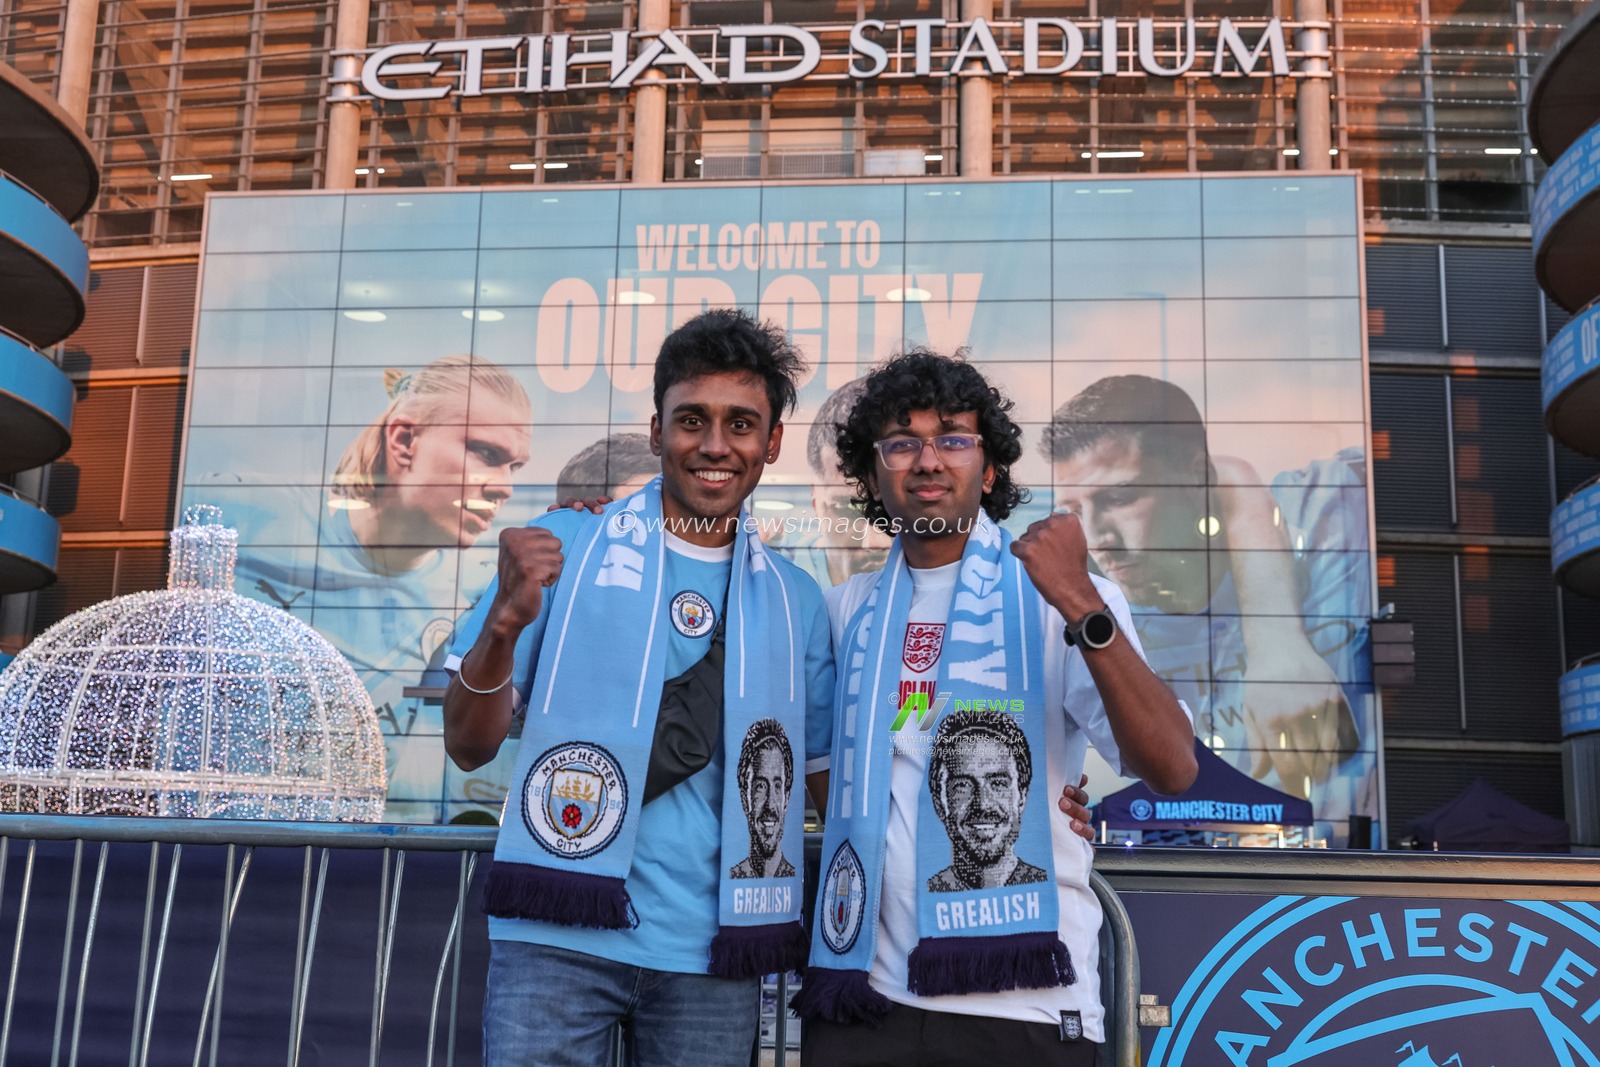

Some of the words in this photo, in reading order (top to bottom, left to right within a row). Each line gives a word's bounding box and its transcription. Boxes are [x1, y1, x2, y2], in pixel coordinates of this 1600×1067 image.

[361, 25, 821, 99] ETIHAD
[849, 17, 1290, 79] STADIUM
[636, 221, 828, 271] WELCOME
[836, 220, 881, 268] TO
[676, 594, 711, 613] MANCHESTER
[541, 750, 617, 791] MANCHESTER
[1155, 801, 1250, 821] MANCHESTER
[1251, 804, 1284, 822] CITY
[556, 838, 582, 852] CITY
[733, 885, 792, 914] GREALISH
[935, 891, 1040, 931] GREALISH
[1214, 908, 1600, 1067] ANCHESTE
